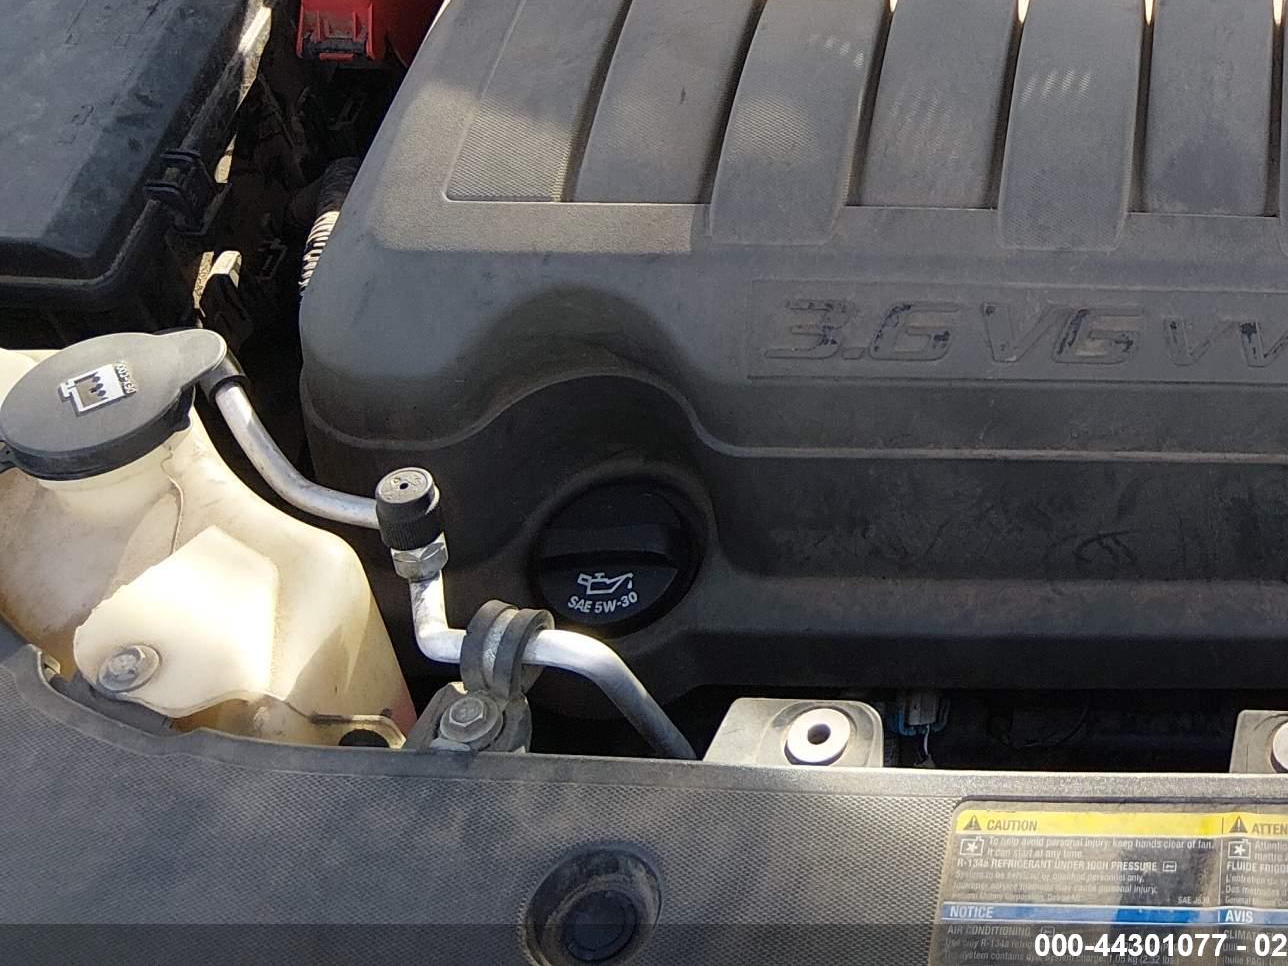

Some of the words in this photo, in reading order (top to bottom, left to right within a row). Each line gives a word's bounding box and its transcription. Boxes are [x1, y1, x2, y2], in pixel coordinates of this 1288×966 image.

[766, 298, 961, 361] 3.6
[980, 302, 1145, 366] V6
[567, 595, 593, 614] SAE
[594, 591, 638, 614] 5W-30
[987, 819, 1038, 831] CAUTION
[990, 836, 999, 846] To
[1001, 836, 1019, 848] help
[1021, 837, 1044, 846] avoid
[1046, 838, 1082, 849] personal
[1112, 839, 1134, 850] keep
[1136, 839, 1162, 849] hands
[1163, 840, 1185, 849] clear
[1187, 840, 1196, 849] of
[996, 850, 1011, 858] can
[1014, 849, 1032, 858] start
[1035, 850, 1043, 858] at
[1046, 850, 1062, 860] any
[957, 858, 989, 868] R-134a
[991, 859, 1051, 869] REFRIGERANT
[1054, 860, 1084, 870] UNDER
[1087, 861, 1108, 871] HIGH
[1110, 861, 1158, 872] PRESSURE
[1226, 861, 1258, 872] FLUIDE
[950, 906, 994, 919] NOTICE
[1225, 910, 1254, 924] AVIS
[947, 925, 964, 935] AIR
[966, 926, 1032, 936] CONDITIONING
[991, 952, 1024, 961] contains
